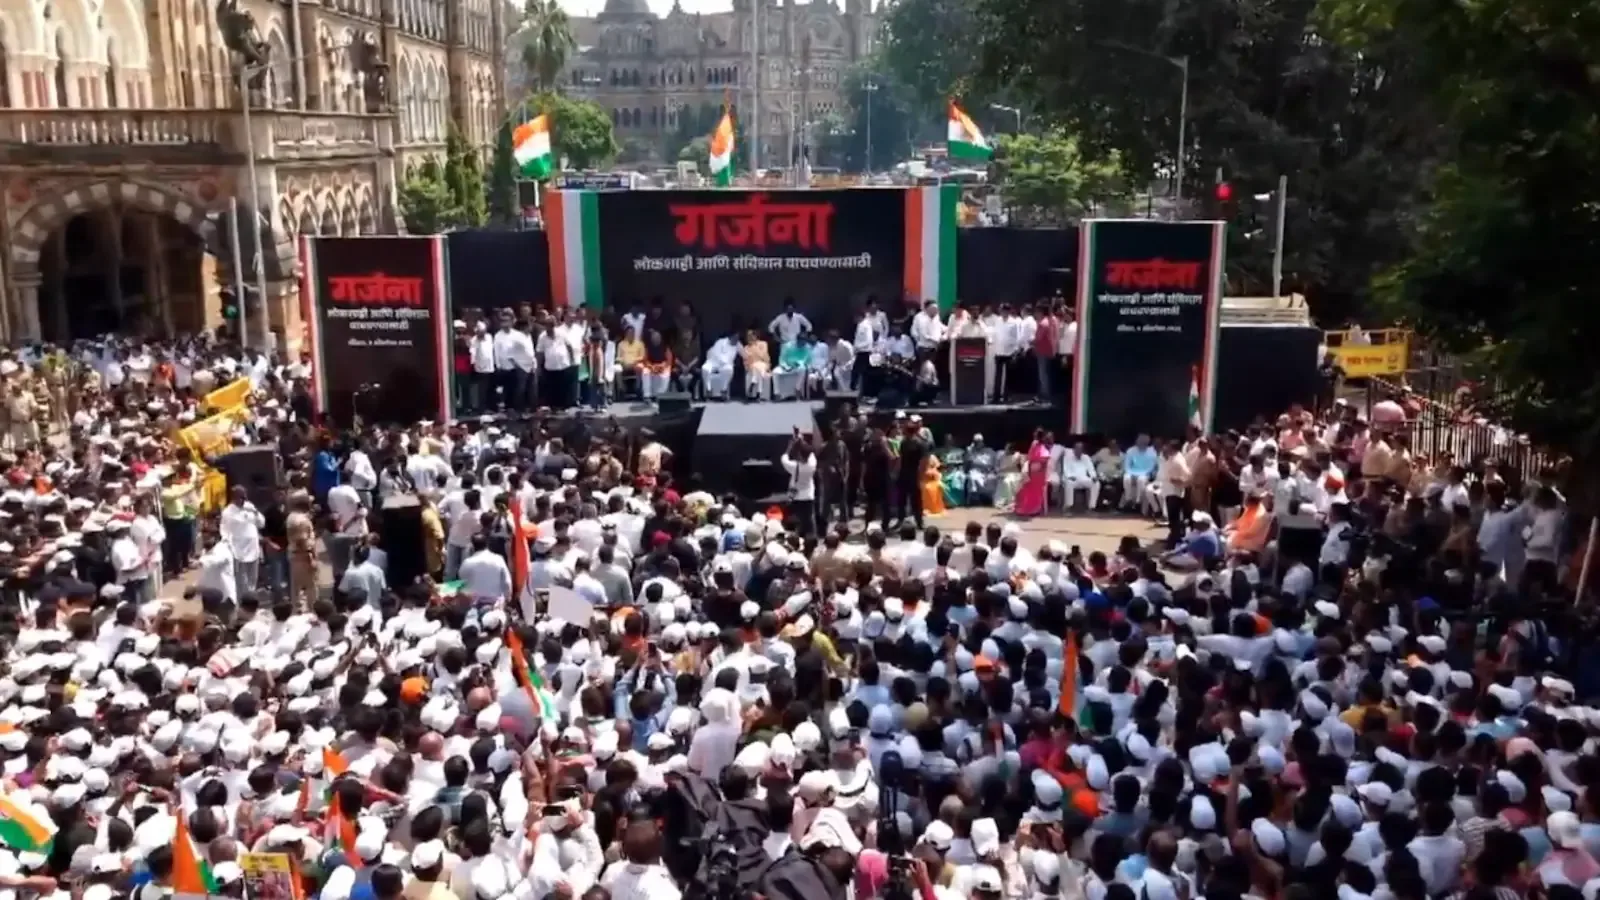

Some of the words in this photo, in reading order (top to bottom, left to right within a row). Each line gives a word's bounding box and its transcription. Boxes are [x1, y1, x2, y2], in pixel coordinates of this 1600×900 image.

[669, 191, 834, 249] गर्जना
[634, 254, 693, 271] लोकशाही
[697, 254, 730, 270] आणि
[1106, 258, 1200, 288] गर्जना
[328, 271, 424, 305] गर्जना
